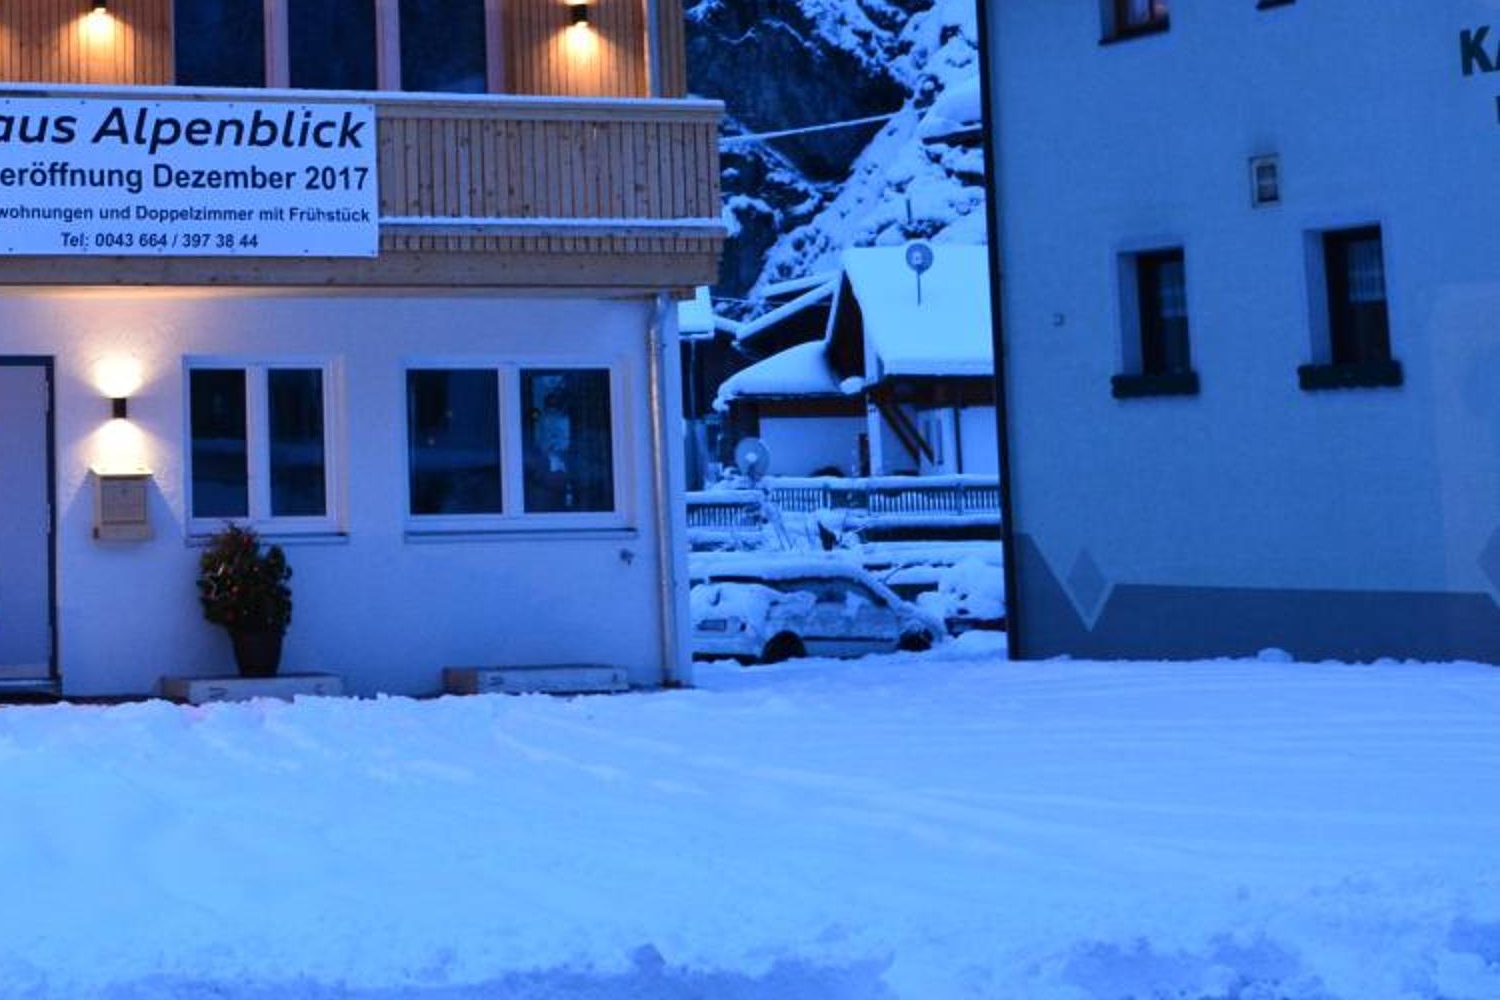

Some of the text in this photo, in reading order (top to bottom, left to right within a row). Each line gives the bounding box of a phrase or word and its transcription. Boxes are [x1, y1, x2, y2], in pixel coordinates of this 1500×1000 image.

[1460, 25, 1500, 76] K
[92, 106, 366, 154] Alpenblick
[153, 164, 297, 190] Dezember
[305, 165, 369, 191] 2017
[100, 205, 131, 220] und
[136, 206, 254, 223] Doppelzimmer
[259, 207, 285, 221] mit
[289, 207, 370, 222] Frühstück
[61, 232, 259, 248] Tel: 0043 664 / 397 38 44
